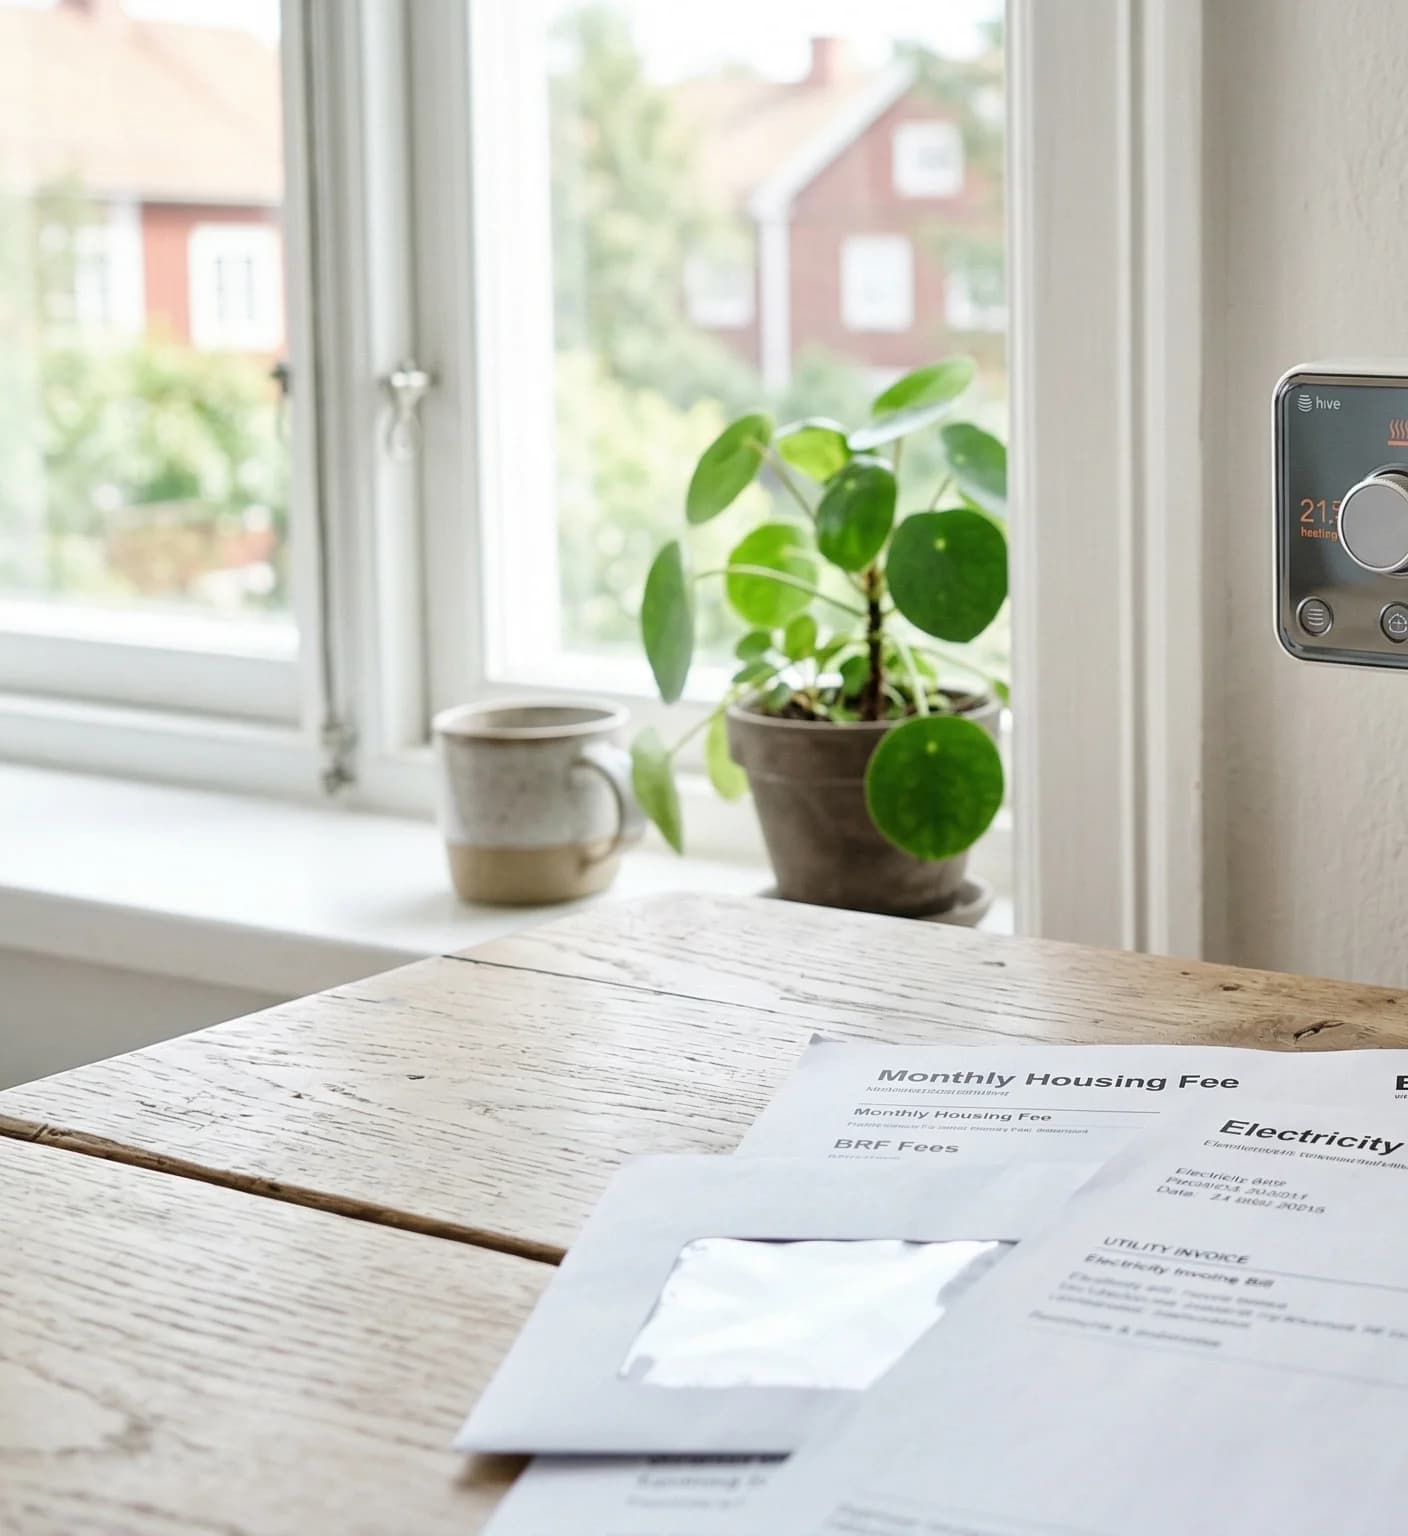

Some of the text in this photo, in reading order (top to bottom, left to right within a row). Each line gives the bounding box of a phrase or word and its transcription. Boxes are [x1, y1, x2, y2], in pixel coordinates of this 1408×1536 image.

[1315, 396, 1341, 411] hive
[878, 1069, 1017, 1089] Monthly
[1025, 1073, 1168, 1092] Housing
[1178, 1074, 1240, 1089] Fee
[853, 1107, 1053, 1122] Monthly Housing Fee
[833, 1138, 960, 1153] BRF Fees
[1218, 1119, 1405, 1157] Electricity
[1103, 1236, 1251, 1265] UTILITY INVOICE
[1085, 1253, 1169, 1275] Electricity
